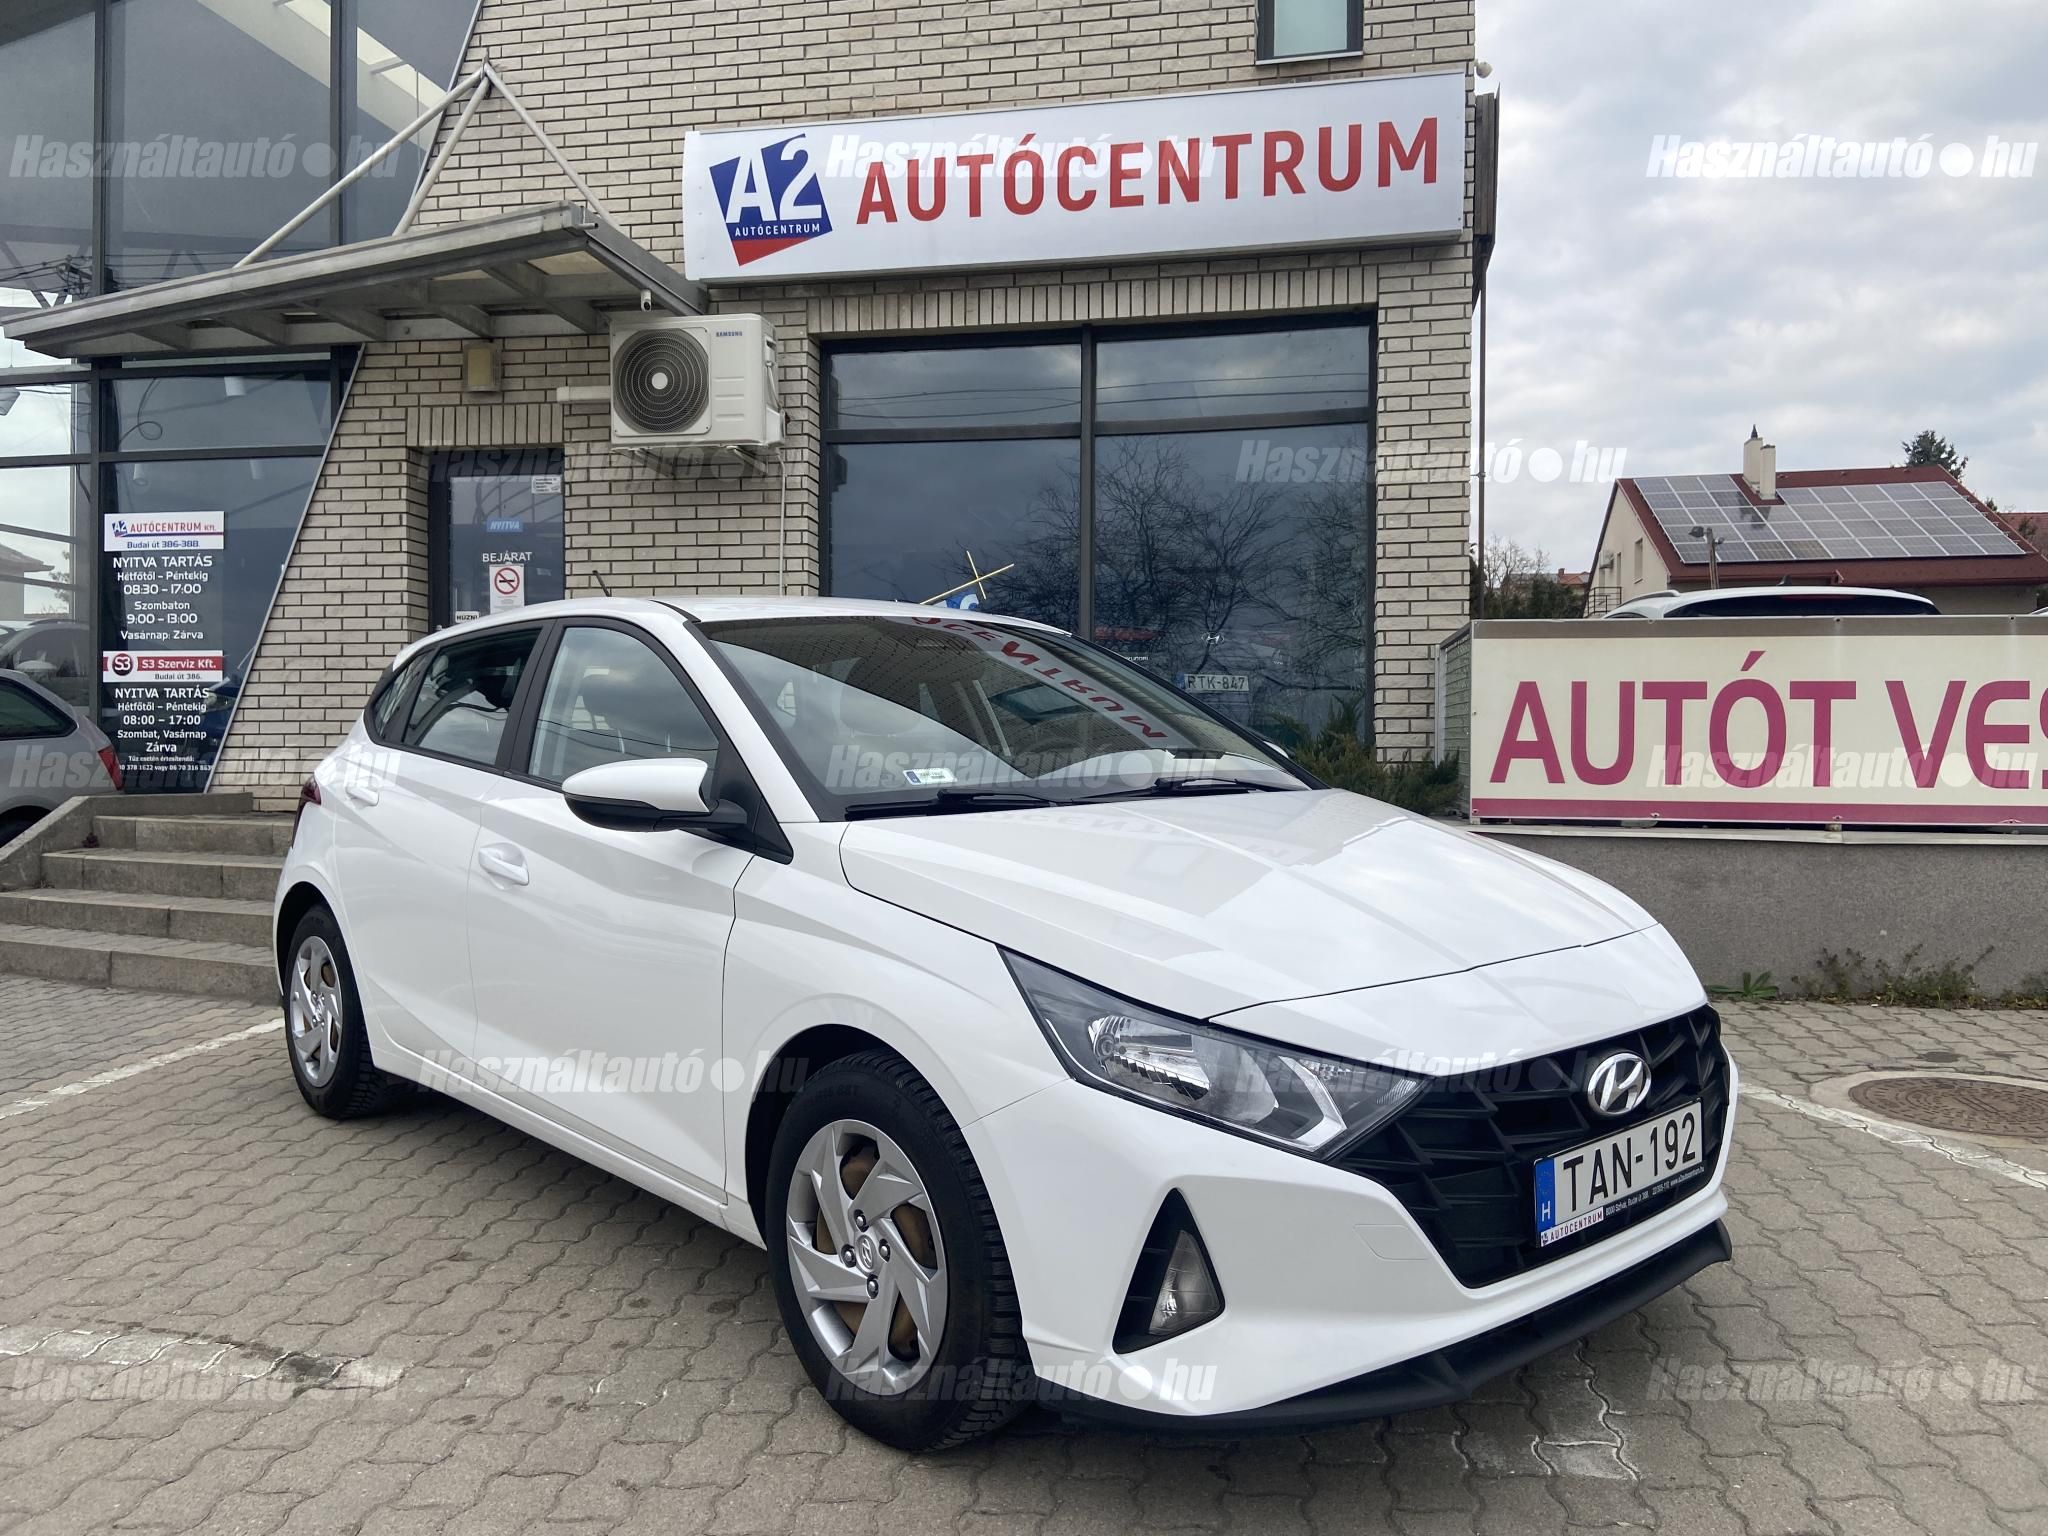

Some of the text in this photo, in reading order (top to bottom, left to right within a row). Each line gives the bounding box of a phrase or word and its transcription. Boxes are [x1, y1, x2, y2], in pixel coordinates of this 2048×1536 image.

[856, 115, 1440, 225] AUTÓCENTRUM
[725, 136, 822, 224] A2
[735, 223, 820, 237] AUTÓCENTRUM
[130, 521, 201, 532] AUTÓCENTRUM
[489, 521, 520, 530] NYITVA
[127, 541, 150, 549] Budai
[113, 553, 213, 569] NYITVA TARTÁS
[482, 550, 532, 562] BEJÁRAT
[117, 571, 156, 581] Hétfőtől
[166, 570, 209, 582] Péntekig
[123, 584, 159, 595] 08:30
[170, 583, 202, 594] 17:00
[134, 601, 191, 611] Szombaton
[127, 613, 155, 624] 9:00
[167, 613, 198, 624] 13:00
[120, 629, 204, 641] Vasárnap: Zárva
[114, 656, 217, 671] S3 S3 Szerviz Kft.
[1187, 675, 1246, 691] RTK-847
[115, 684, 209, 699] NYITVA TARTÁS
[117, 702, 155, 711] Hétfőtől
[166, 702, 207, 713] Péntekig
[123, 715, 155, 725] 08:00
[168, 715, 201, 725] 17:00
[1489, 650, 2048, 790] AUTÓT VE
[117, 729, 207, 740] Szombat, Vasárnap
[145, 741, 177, 752] Zárva
[1563, 1111, 1696, 1213] TAN-192
[1541, 1200, 1551, 1222] H
[1550, 1210, 1603, 1242] AUTÓCENTRUM
